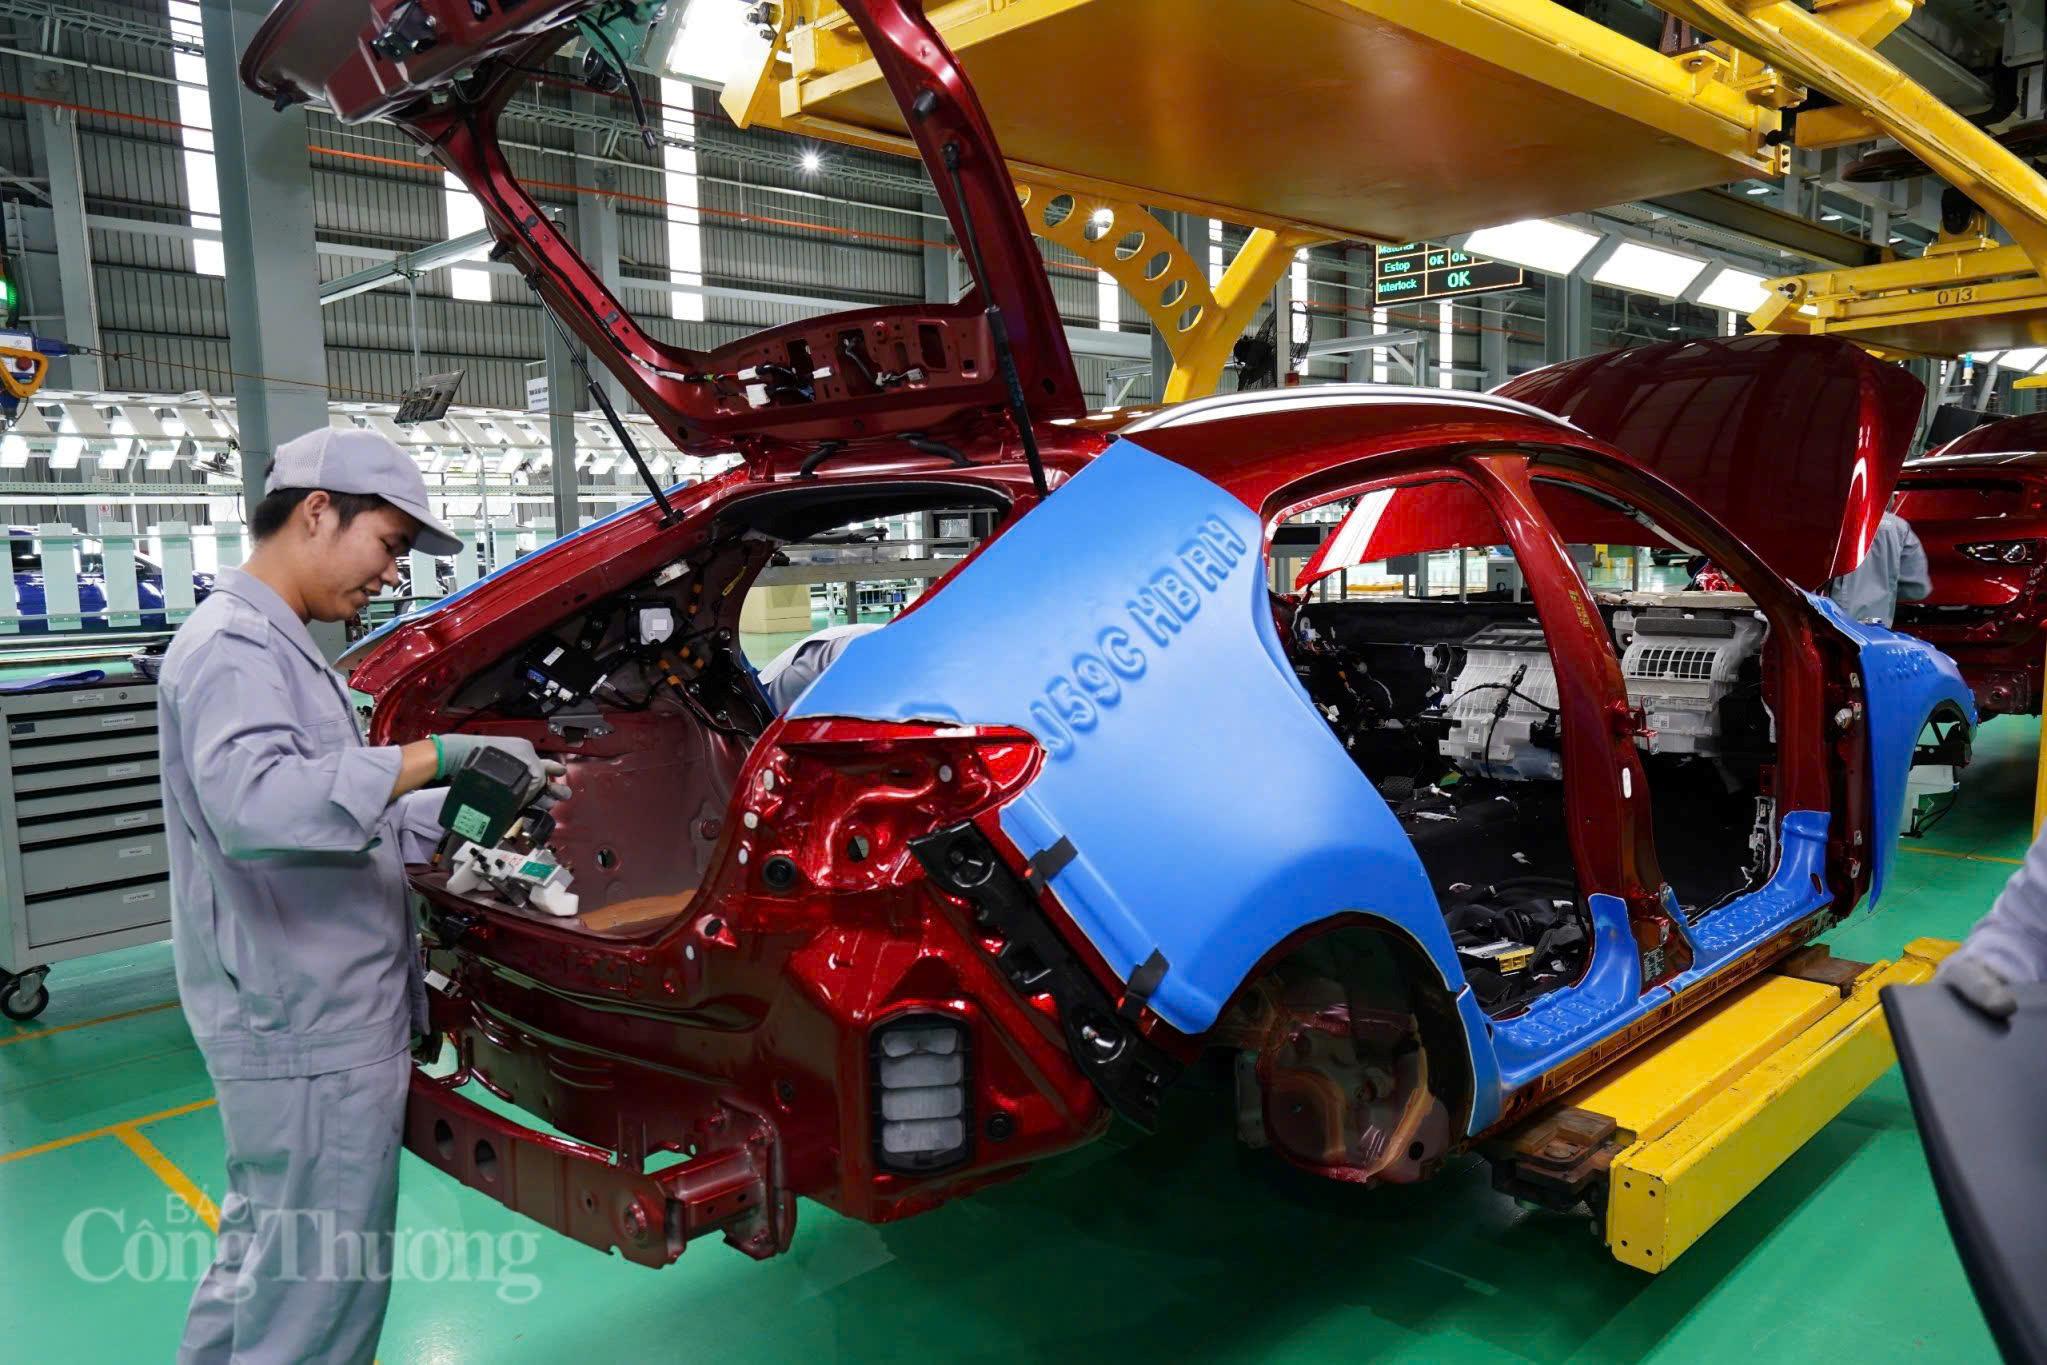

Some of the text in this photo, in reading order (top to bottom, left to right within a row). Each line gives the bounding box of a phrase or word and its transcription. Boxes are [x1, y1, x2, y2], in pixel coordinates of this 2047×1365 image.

[1384, 261, 1411, 273] Estop
[1429, 254, 1445, 266] OK
[1378, 270, 1471, 293] Interlock OK
[1126, 565, 1202, 649] HB
